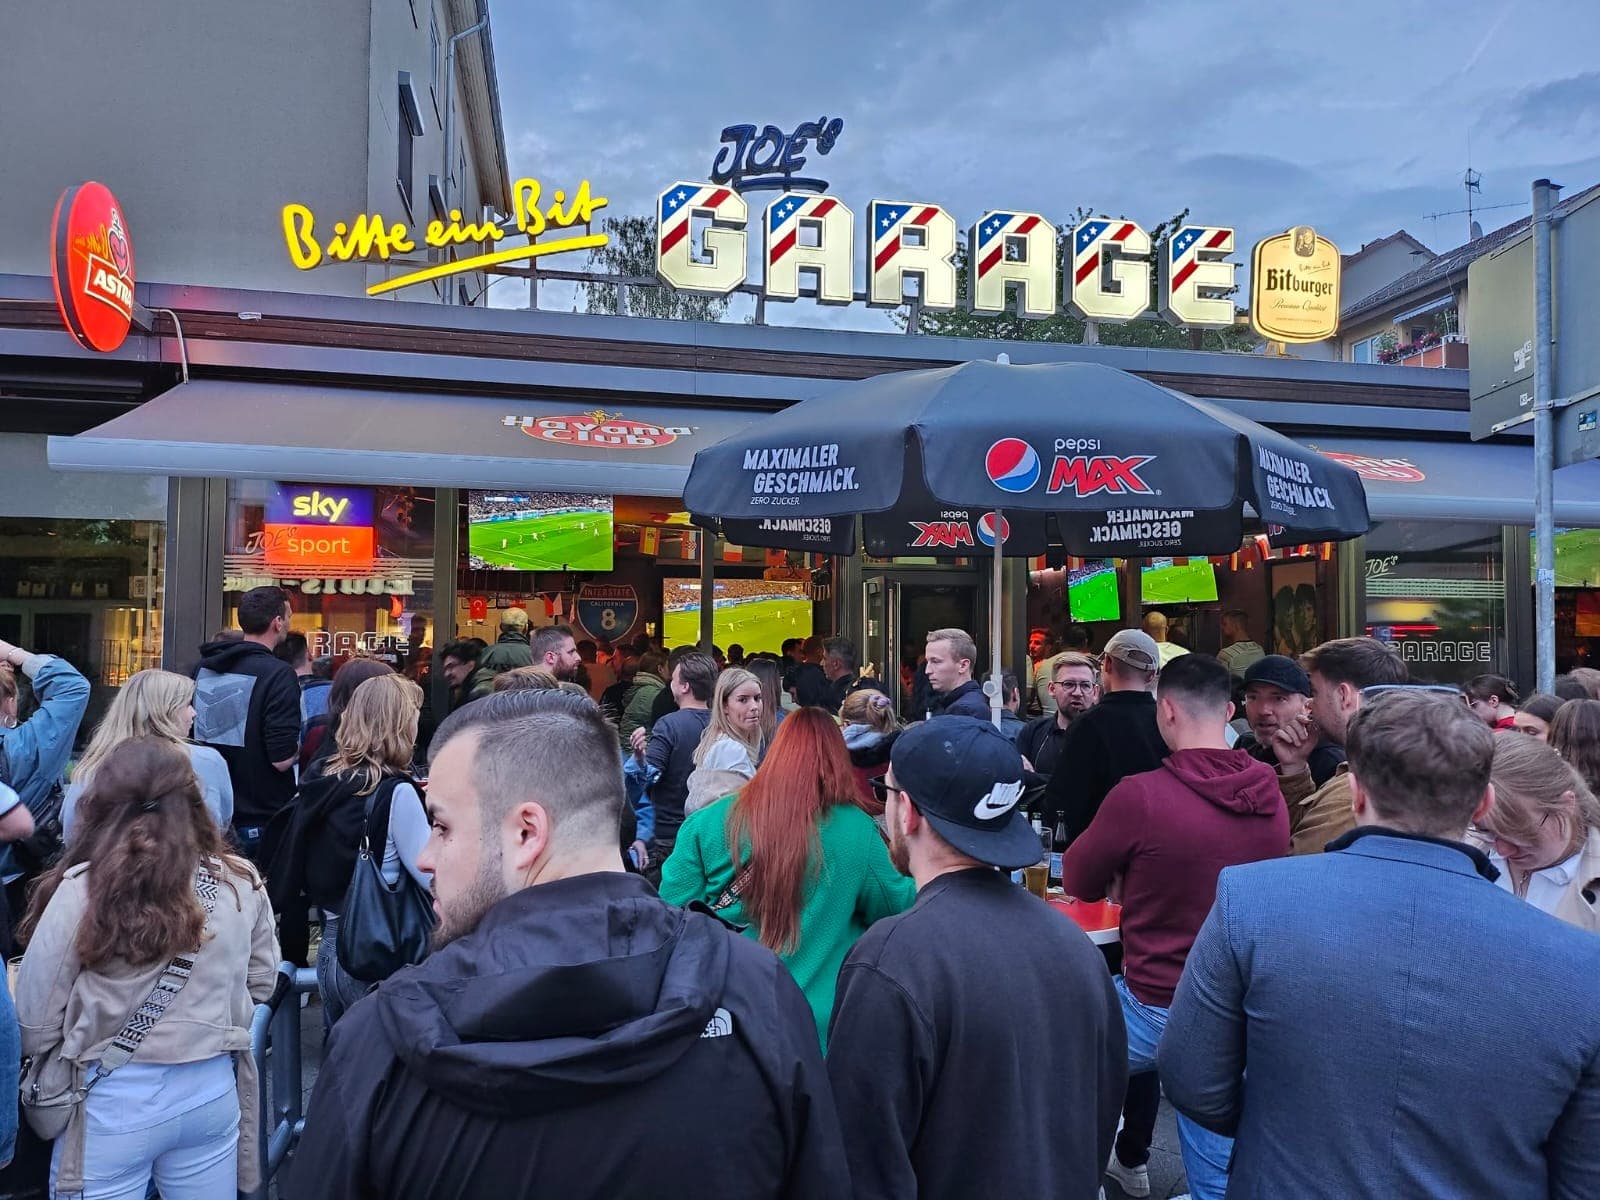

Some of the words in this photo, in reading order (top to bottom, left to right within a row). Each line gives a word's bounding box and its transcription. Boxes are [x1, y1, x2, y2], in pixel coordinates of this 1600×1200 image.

[283, 203, 415, 270] Bitte
[425, 209, 504, 247] ein
[513, 178, 608, 235] Bit
[656, 180, 1235, 330] GARAGE
[93, 268, 132, 308] ASTRA
[1265, 268, 1333, 297] Bitburger
[501, 416, 694, 435] Havana
[543, 429, 655, 445] Club
[742, 444, 839, 470] MAXIMALER
[1055, 438, 1101, 453] pepsi
[753, 467, 860, 494] GESCHMACK.
[1046, 455, 1158, 498] MAX
[293, 491, 348, 522] sky
[750, 496, 770, 505] ZERO
[287, 537, 350, 556] sport
[584, 588, 631, 597] INTERSTATE
[601, 609, 616, 630] 8
[306, 631, 410, 656] RAGE
